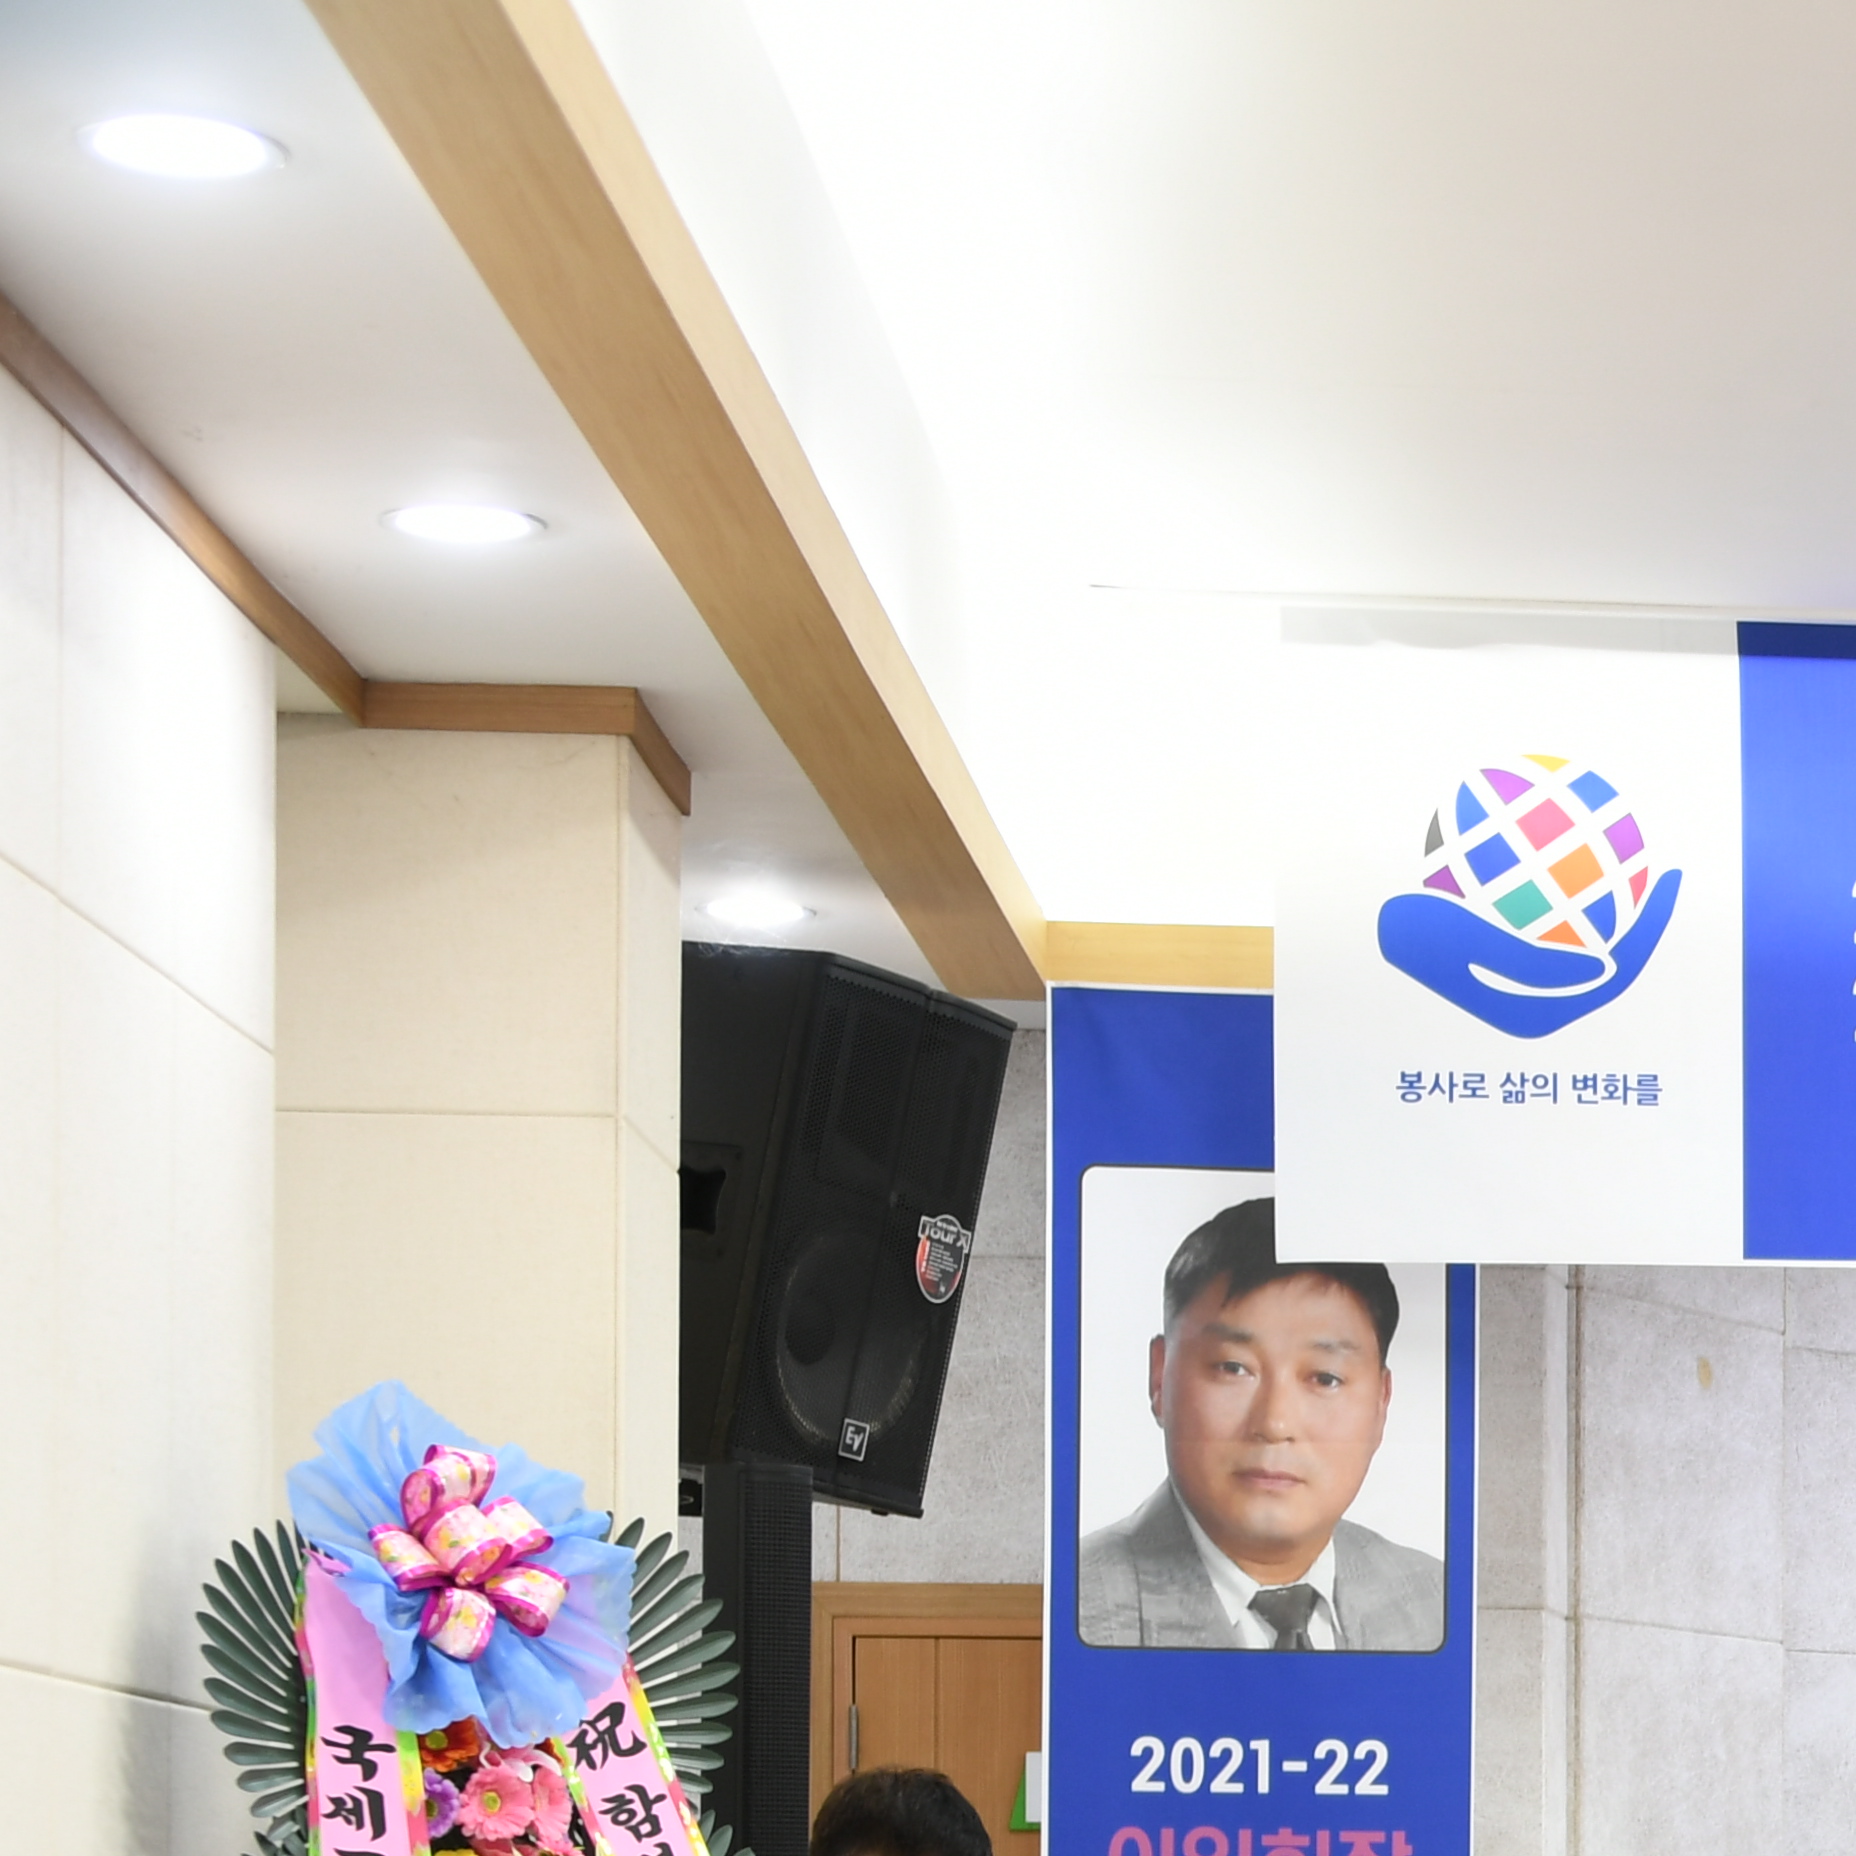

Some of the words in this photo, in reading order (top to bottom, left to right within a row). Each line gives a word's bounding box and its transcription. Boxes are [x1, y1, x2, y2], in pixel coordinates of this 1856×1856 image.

[1396, 1071, 1490, 1103] 봉사로
[1499, 1072, 1558, 1104] 삶의
[1571, 1073, 1663, 1106] 변화를
[566, 1701, 648, 1772] 祝
[1129, 1736, 1390, 1796] 2021-22
